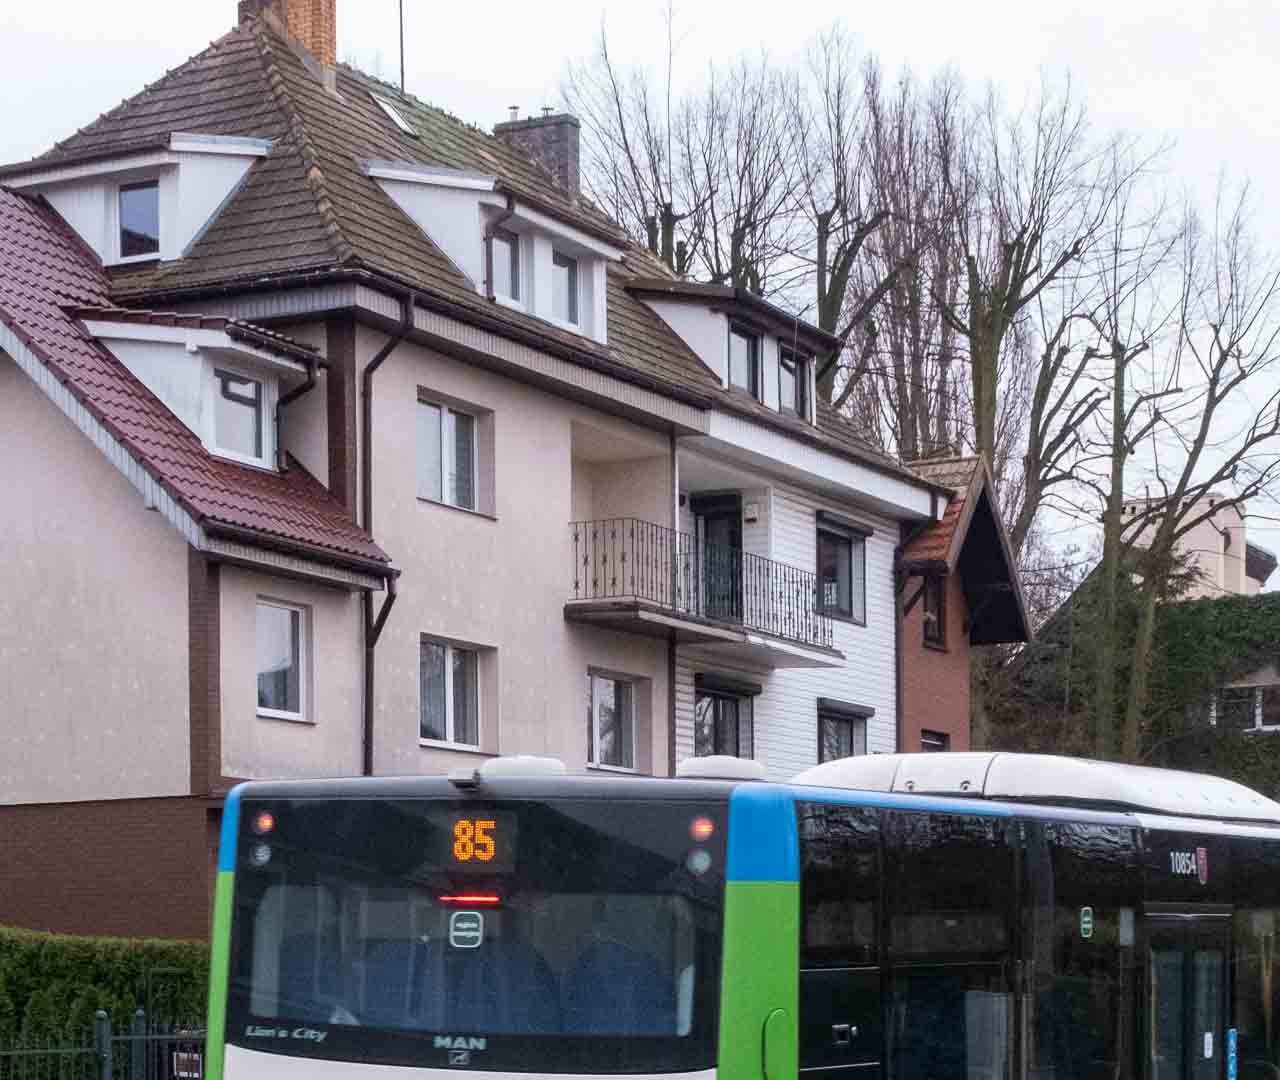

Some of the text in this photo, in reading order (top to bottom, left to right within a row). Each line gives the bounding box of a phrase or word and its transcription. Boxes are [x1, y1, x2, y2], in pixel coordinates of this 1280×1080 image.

[453, 819, 496, 861] 85
[1170, 851, 1197, 875] 10854
[291, 1027, 328, 1042] City
[433, 1035, 487, 1050] MAN
